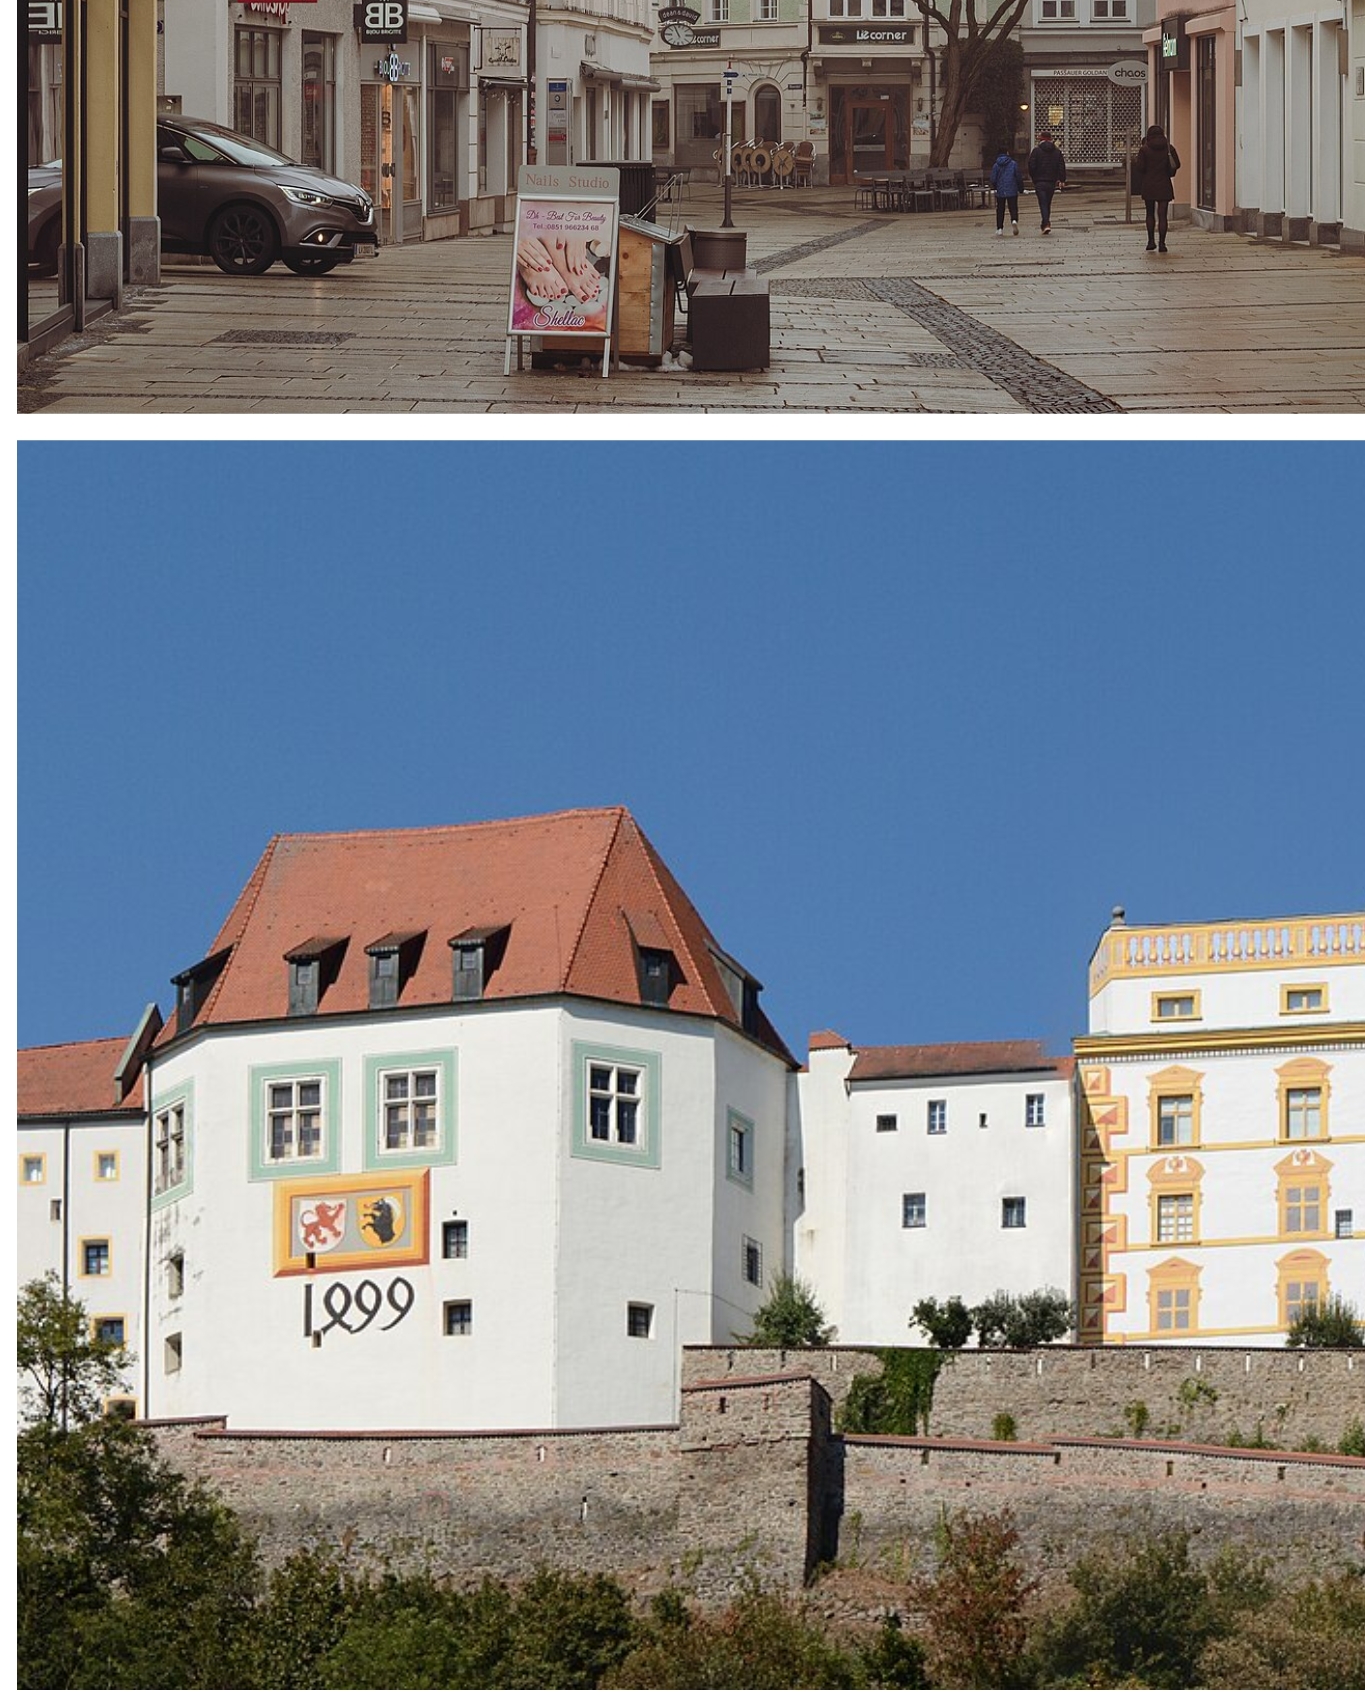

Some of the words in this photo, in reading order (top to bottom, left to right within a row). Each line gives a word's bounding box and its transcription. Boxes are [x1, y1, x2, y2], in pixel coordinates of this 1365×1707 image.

[1114, 67, 1146, 78] chaos
[526, 173, 559, 187] Nails
[569, 175, 610, 188] Studio
[533, 305, 586, 328] Shellac
